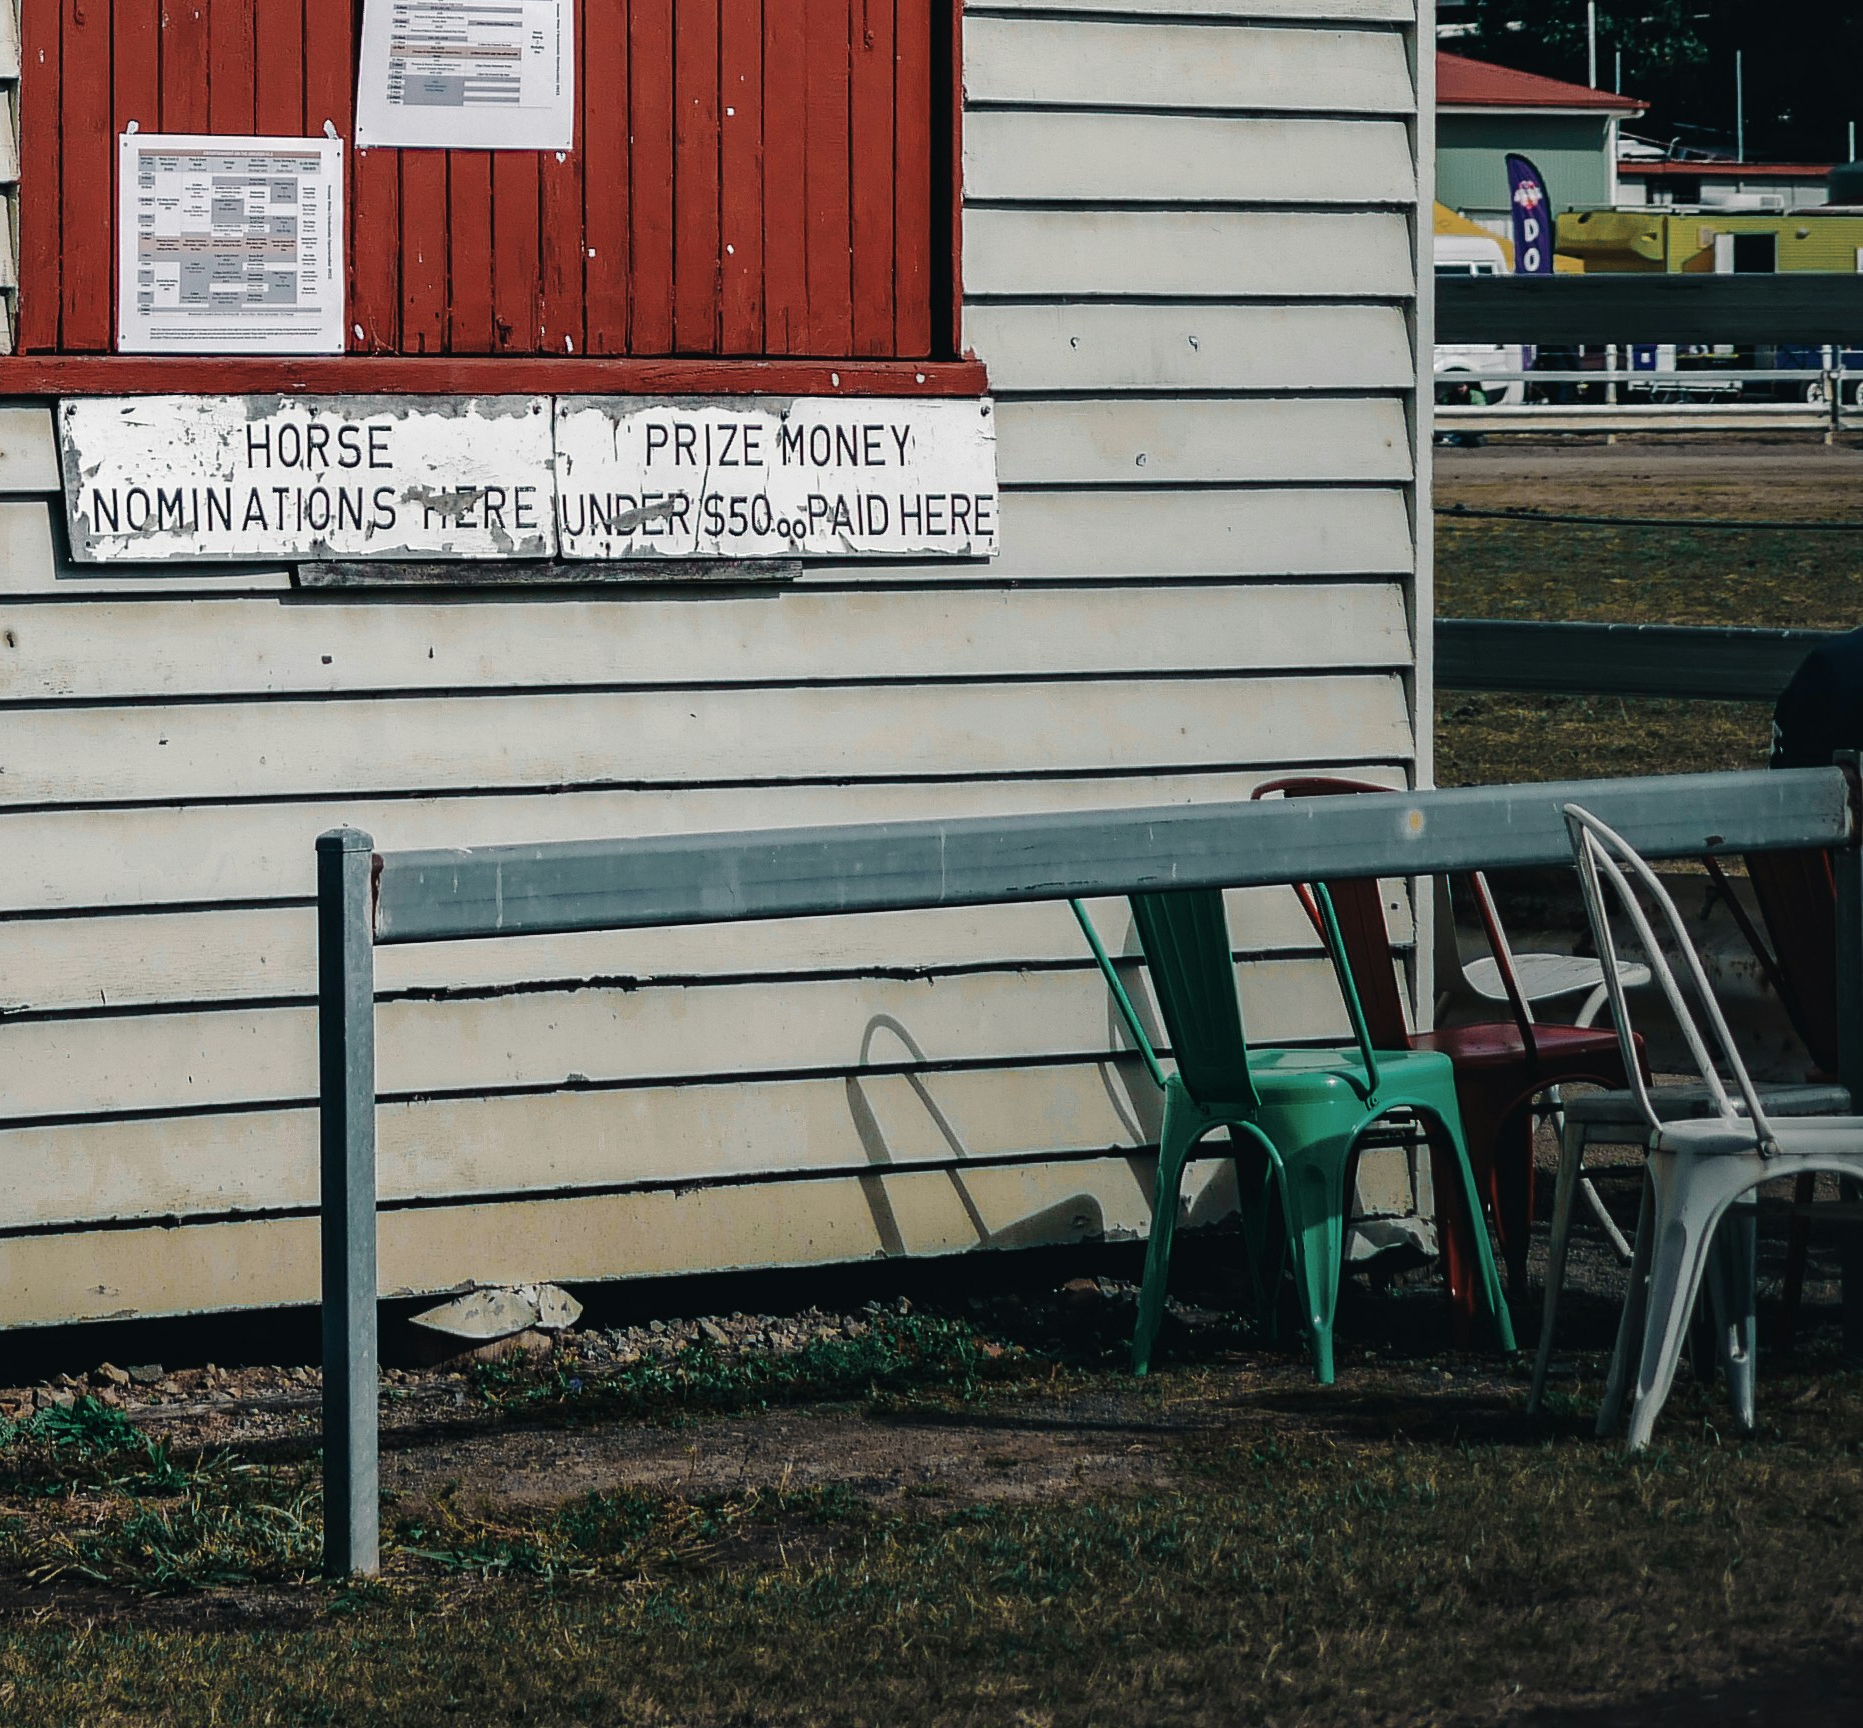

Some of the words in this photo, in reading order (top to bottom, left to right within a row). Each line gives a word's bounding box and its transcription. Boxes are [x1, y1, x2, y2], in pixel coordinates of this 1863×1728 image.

[246, 423, 394, 469] HORSE
[646, 423, 764, 467] PRIZE
[781, 423, 911, 467] MONEY
[92, 485, 397, 533] NOMINATIONS
[562, 492, 691, 537] UNDER
[807, 493, 889, 536] PAID
[900, 493, 995, 536] HERE
